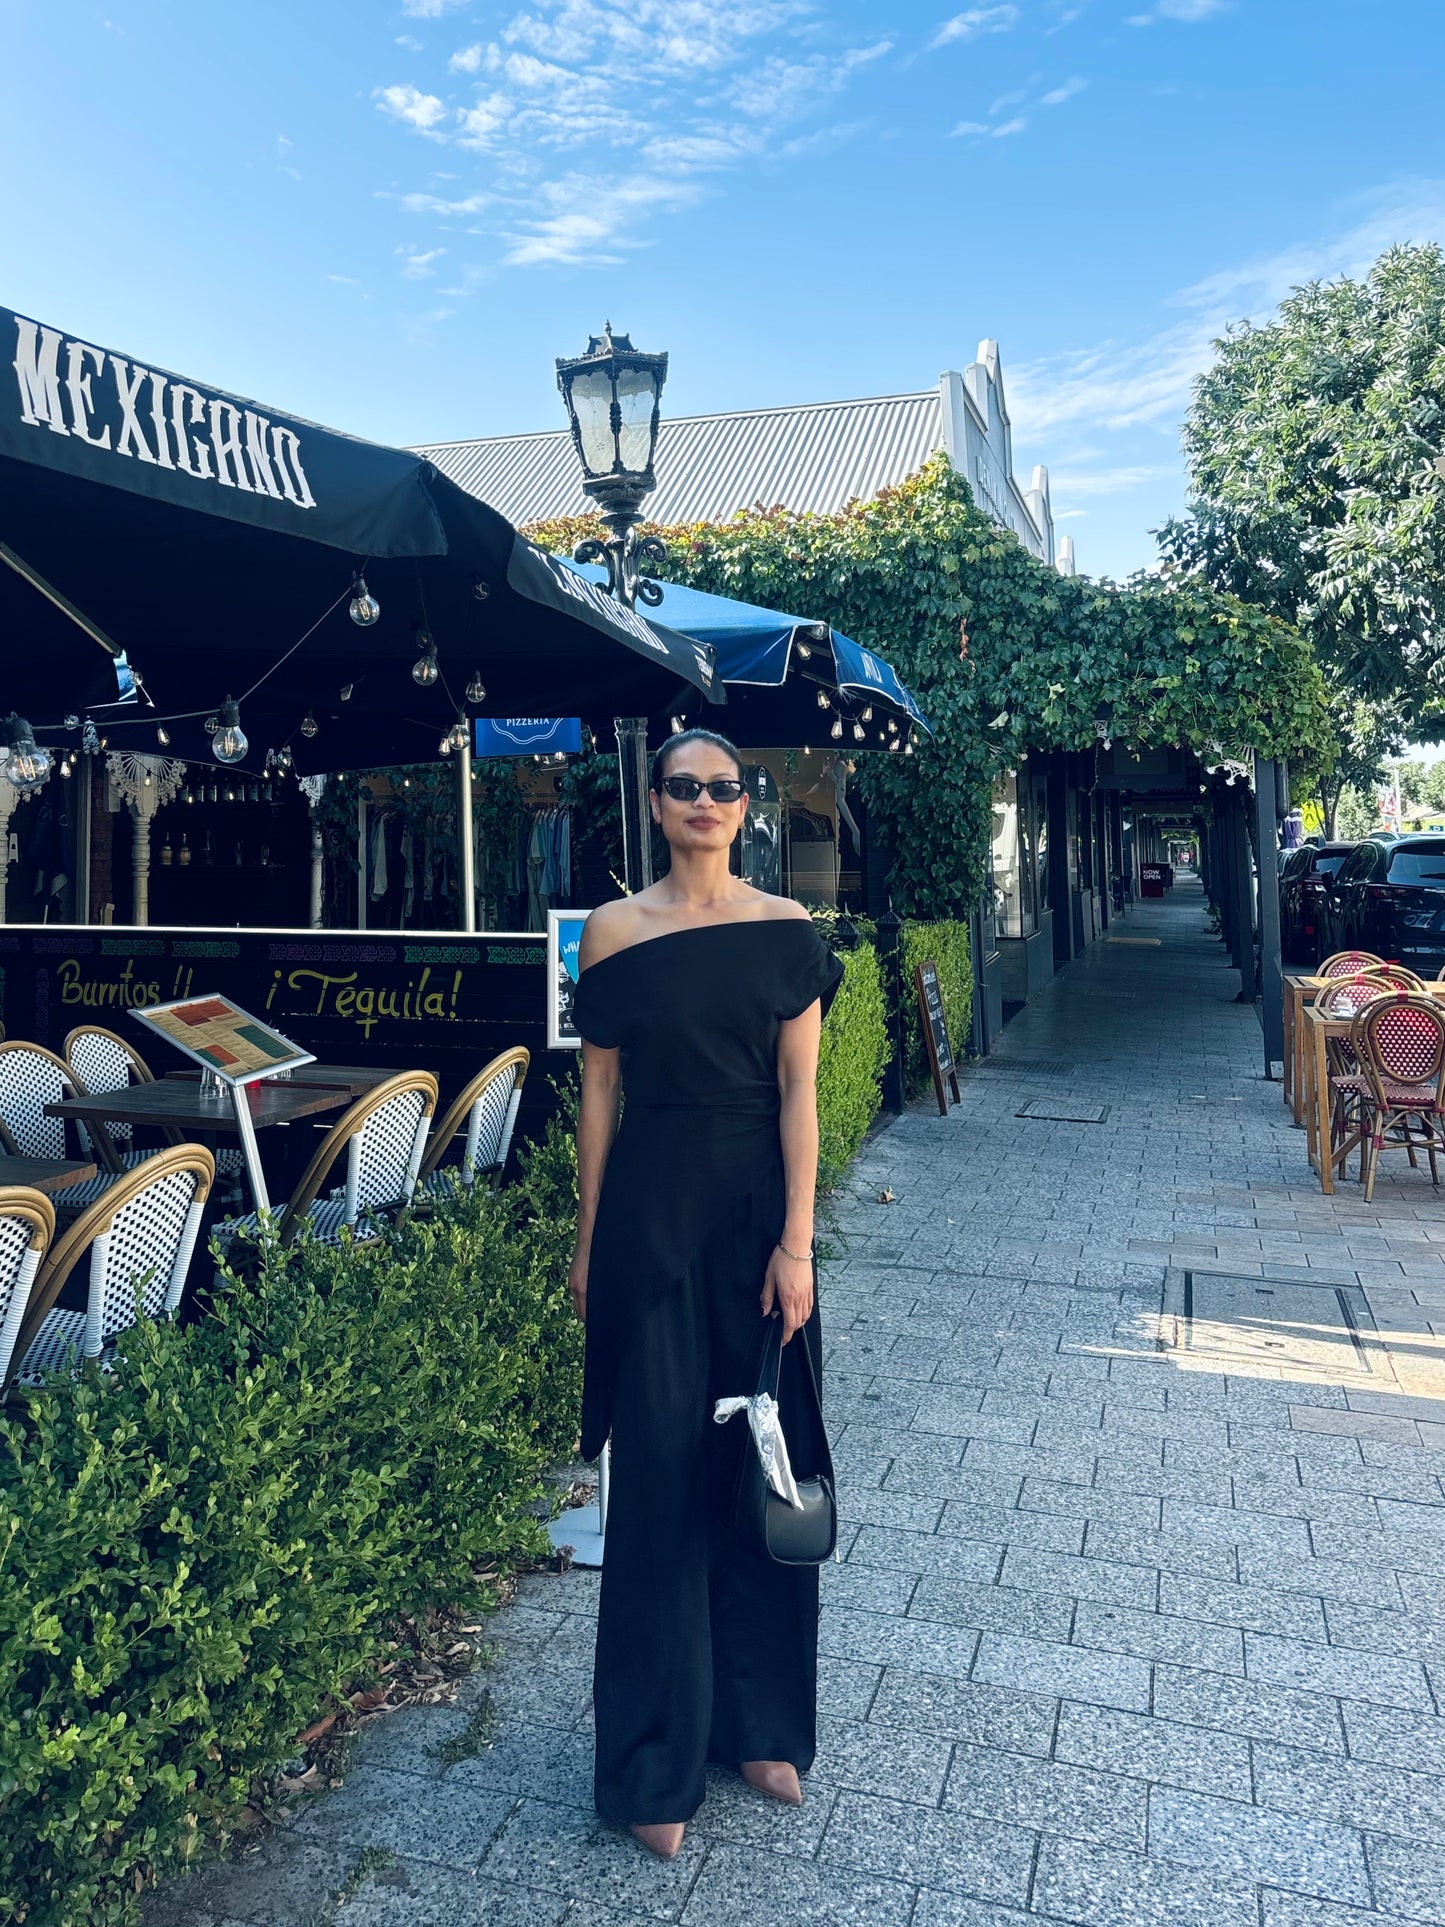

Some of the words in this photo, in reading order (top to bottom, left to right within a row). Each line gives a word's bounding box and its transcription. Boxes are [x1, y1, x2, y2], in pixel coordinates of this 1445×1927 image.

[12, 315, 317, 509] MEXICANO
[506, 717, 550, 726] PIZZERIA
[56, 959, 161, 1008] Burritos
